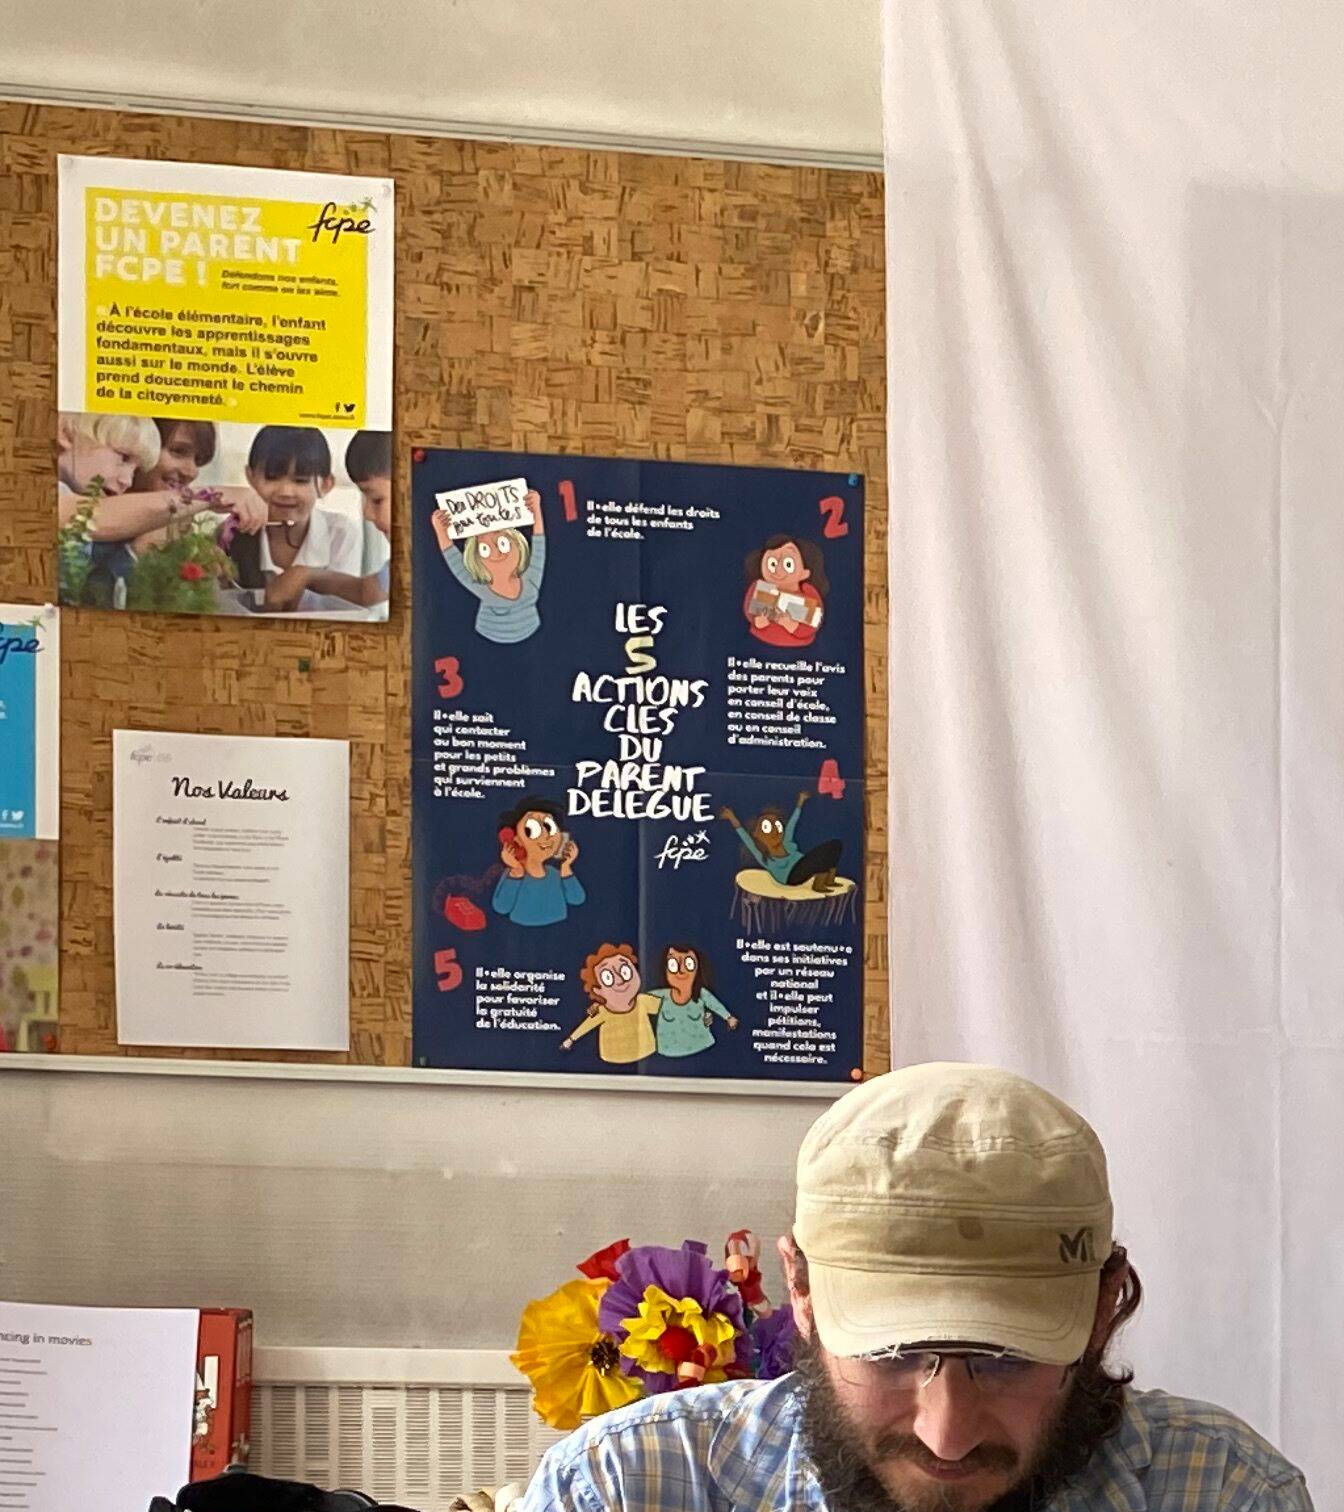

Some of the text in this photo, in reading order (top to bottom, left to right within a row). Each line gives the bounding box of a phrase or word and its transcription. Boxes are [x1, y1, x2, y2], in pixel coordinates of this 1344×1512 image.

[95, 197, 262, 233] DEVENEZ
[307, 201, 377, 244] fcpe
[95, 225, 302, 263] UN PARENT
[95, 254, 208, 285] FCPE !
[96, 320, 166, 337] découvre
[197, 328, 310, 347] apprentissages
[125, 306, 173, 320] l'école
[272, 314, 326, 331] l'enfant
[96, 355, 136, 367] aussi
[141, 358, 165, 369] sur
[212, 346, 248, 358] mais
[96, 371, 140, 384] prend
[144, 373, 228, 389] doucement
[249, 380, 304, 394] chemin
[96, 386, 115, 398] de
[120, 387, 132, 399] la
[558, 480, 578, 521] 1
[624, 502, 665, 516] défend
[685, 506, 720, 519] droits
[819, 496, 849, 539] 2
[650, 517, 694, 530] enfants
[615, 601, 668, 635] LES
[624, 635, 658, 675] 5
[435, 656, 464, 699] 3
[571, 671, 709, 708] ACTIONS
[603, 703, 679, 735] CLES
[617, 733, 662, 763] DU
[172, 776, 291, 801] Nos Valeurs
[575, 758, 706, 792] PARENT
[817, 759, 846, 800] 4
[567, 787, 715, 822] DELEGUE
[654, 834, 709, 870] fcpe
[434, 948, 463, 992] 5
[33, 1333, 45, 1344] in
[48, 1335, 92, 1346] movies
